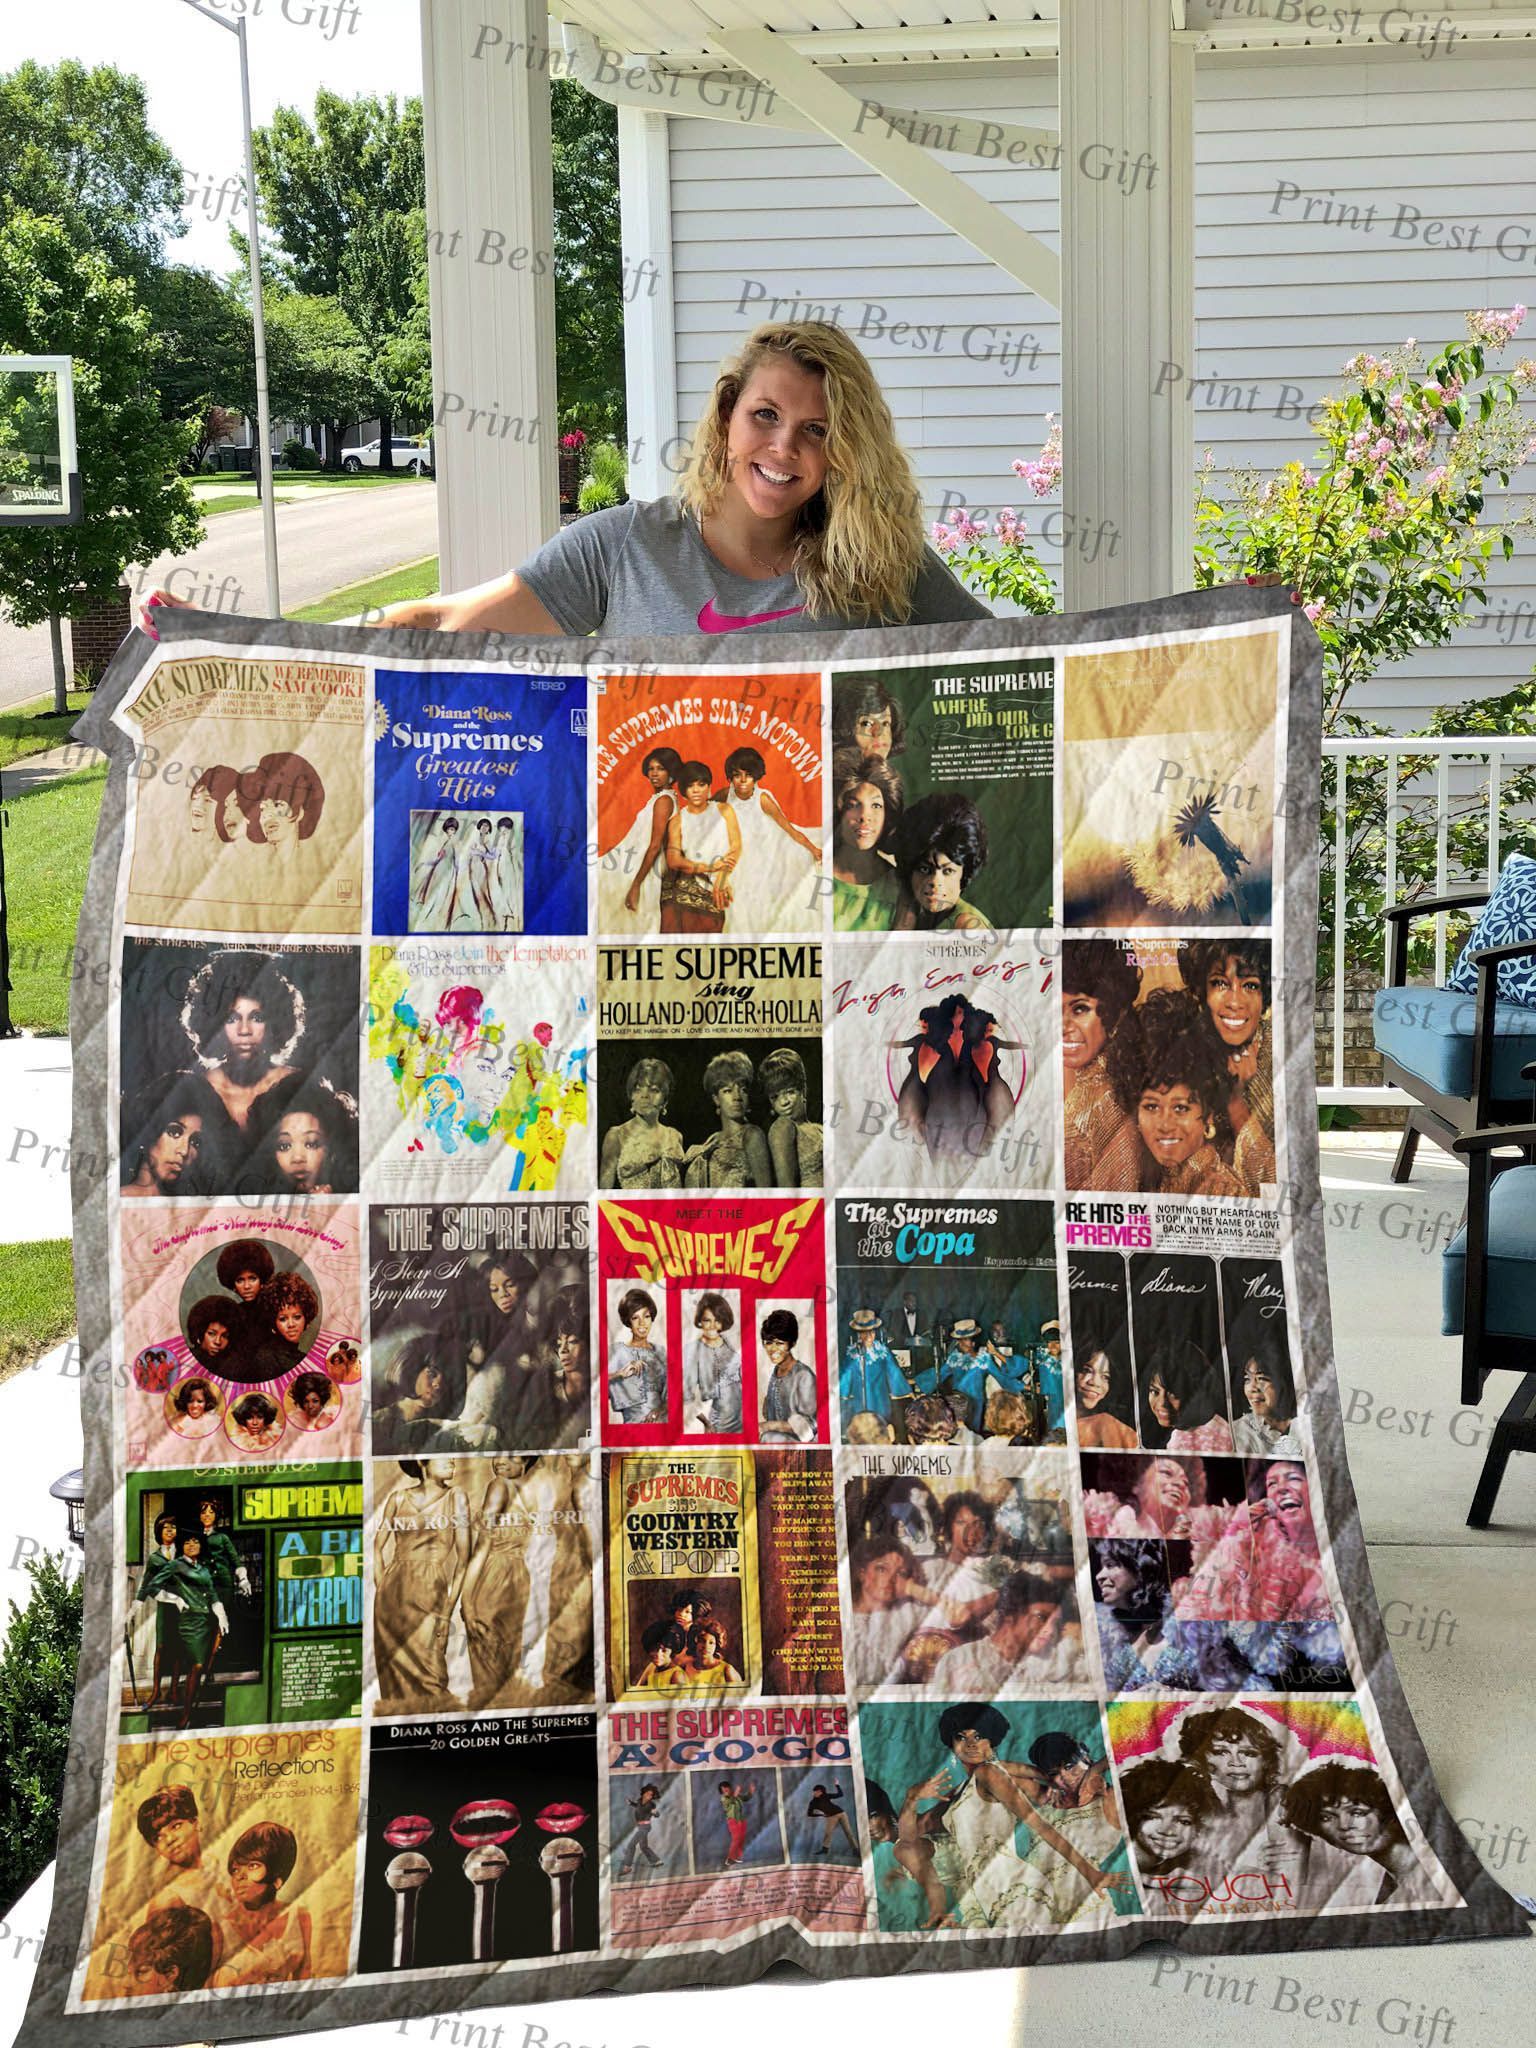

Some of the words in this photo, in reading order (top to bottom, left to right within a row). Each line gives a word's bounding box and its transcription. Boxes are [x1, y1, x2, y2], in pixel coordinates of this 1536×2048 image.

[12, 489, 61, 501] SPALDING
[171, 661, 269, 700] SUPREMES
[274, 665, 294, 680] WE
[272, 680, 307, 693] SAM
[530, 681, 566, 691] STEREO
[932, 677, 966, 696] THE
[422, 704, 471, 720] Diana
[471, 705, 513, 724] Ross
[932, 698, 988, 715] WHERE
[966, 712, 993, 728] DID
[996, 710, 1029, 726] OUR
[392, 722, 544, 755] Supremes
[609, 698, 703, 755] SUPREMES
[709, 698, 754, 730] SING
[752, 710, 823, 783] MOTOWN
[1005, 723, 1040, 739] LOVE
[415, 754, 519, 780] Greatest
[437, 776, 497, 804] Hits
[1135, 939, 1189, 950] Supremes
[442, 962, 506, 977] Supremes
[599, 948, 664, 981] THE
[675, 946, 823, 980] SUPREME
[695, 981, 755, 1001] sing
[676, 1209, 712, 1219] MEET
[717, 1209, 744, 1219] THE
[844, 1203, 887, 1223] The
[891, 1203, 998, 1229] Supremes
[1090, 1203, 1124, 1224] HITS
[1128, 1205, 1147, 1214] BY
[1126, 1215, 1150, 1225] THE
[1157, 1205, 1199, 1215] NOTHING
[1201, 1207, 1218, 1216] BUT
[1220, 1208, 1278, 1219] HEARTACHES
[1184, 1216, 1194, 1224] IN
[1196, 1217, 1214, 1225] THE
[1216, 1218, 1243, 1227] NAME
[1245, 1219, 1257, 1227] OF
[384, 1208, 432, 1251] THE
[442, 1206, 590, 1251] SUPREMES
[1163, 1225, 1186, 1234] BACK
[1189, 1226, 1199, 1235] IN
[1201, 1226, 1215, 1235] MY
[1217, 1227, 1243, 1237] ARMS
[1246, 1229, 1275, 1238] AGAIN
[598, 1198, 820, 1284] SUPREMES
[857, 1238, 893, 1257] the
[895, 1224, 975, 1264] Copa
[382, 1256, 431, 1281] Hear
[370, 1279, 448, 1310] Symphony
[668, 1463, 696, 1474] THE
[862, 1455, 885, 1474] THE
[892, 1455, 952, 1475] SUPREMES
[627, 1475, 739, 1508] SUPREMES
[627, 1512, 739, 1531] COUNTRY
[279, 1532, 309, 1556] A
[627, 1531, 739, 1550] WESTERN
[390, 1725, 431, 1738] DIANA
[437, 1724, 467, 1735] ROSS
[471, 1721, 500, 1732] AND
[504, 1719, 527, 1730] THE
[531, 1716, 590, 1729] SUPREMES
[607, 1711, 668, 1742] THE
[676, 1707, 849, 1739] SUPREMES
[430, 1739, 446, 1750] 20
[449, 1737, 500, 1749] GOLDEN
[504, 1733, 550, 1745] GREATS
[234, 1757, 335, 1779] Reflections
[1152, 1873, 1293, 1903] TOUCH
